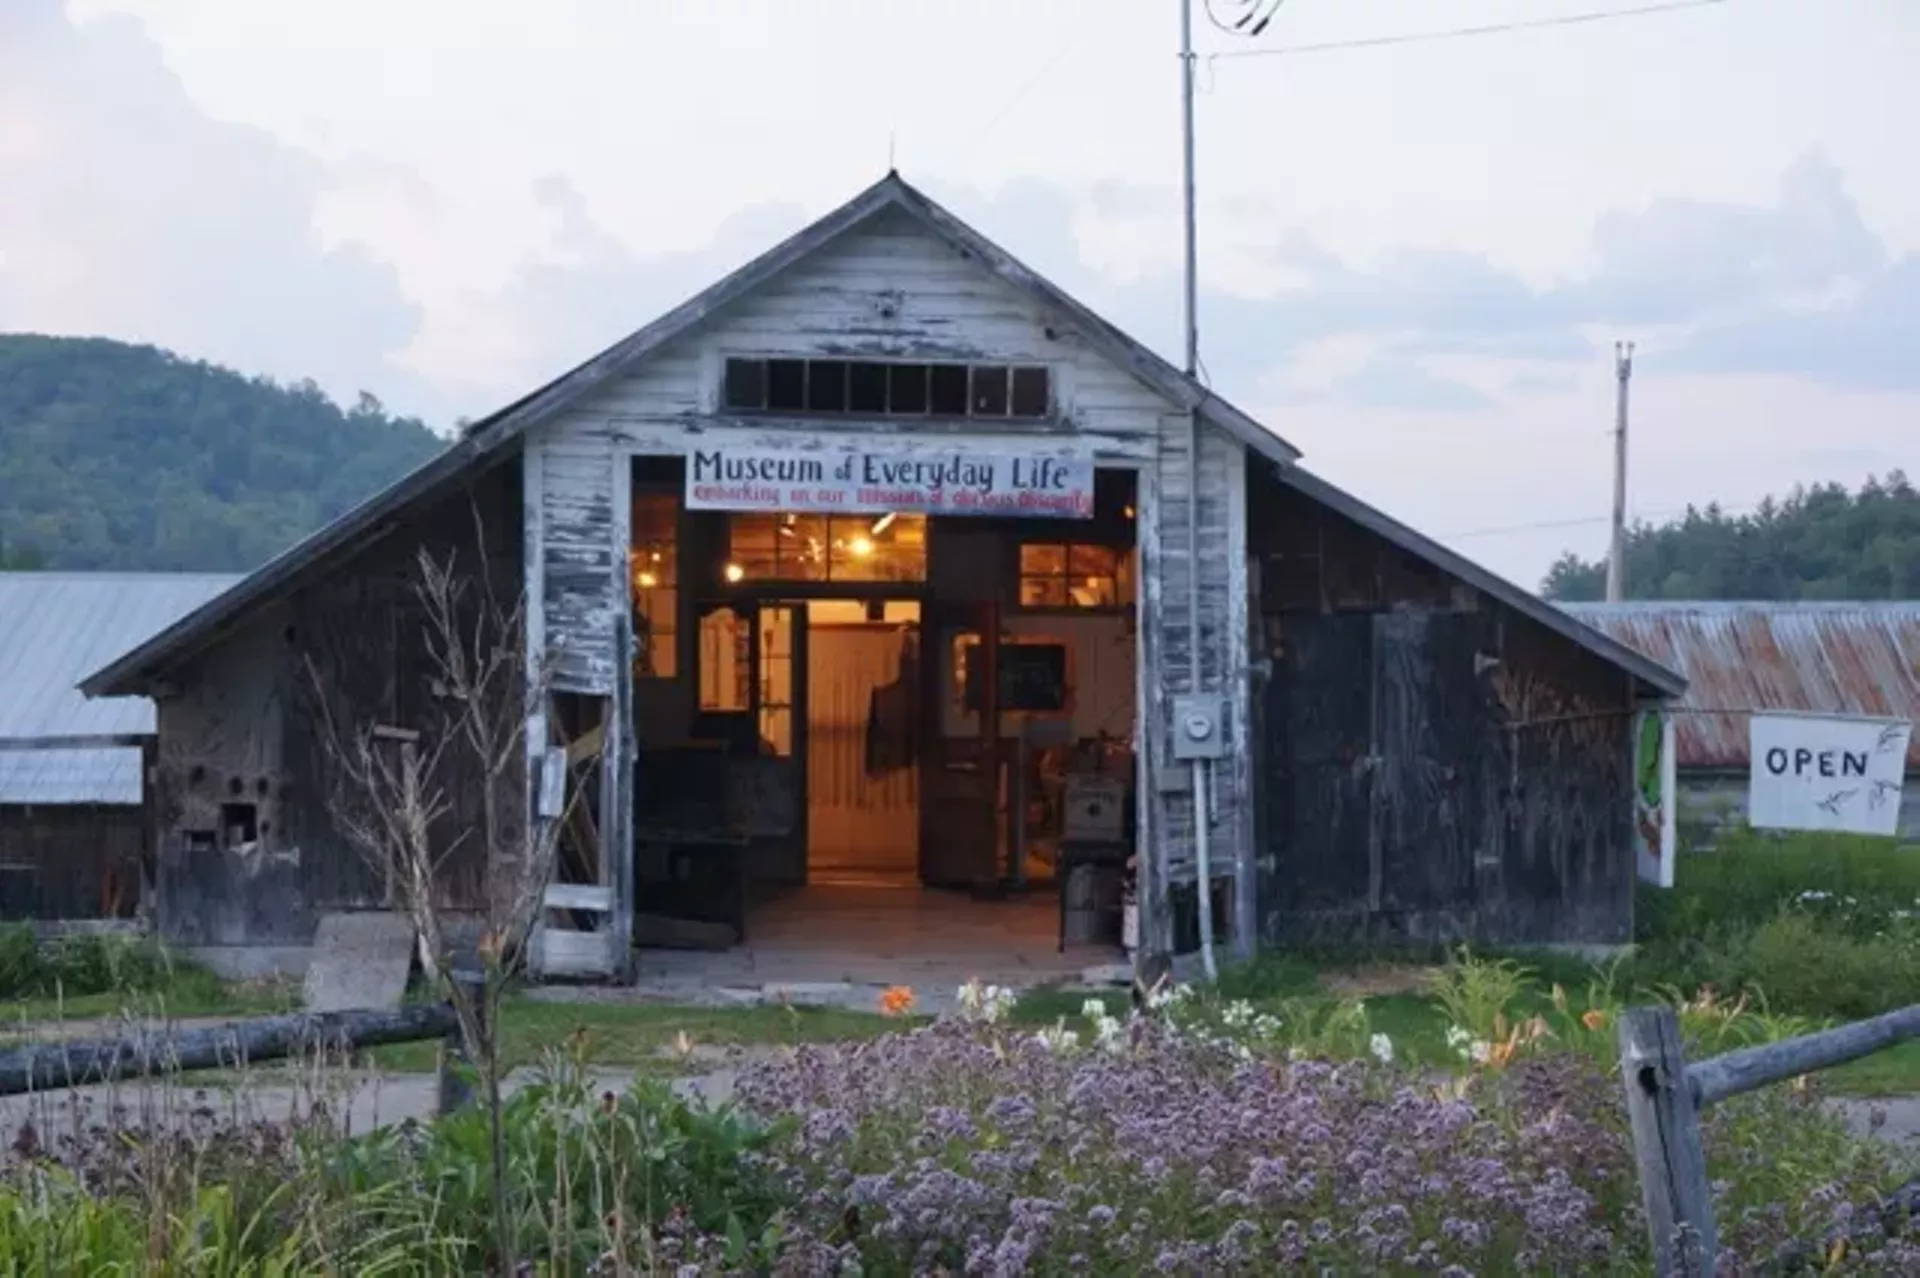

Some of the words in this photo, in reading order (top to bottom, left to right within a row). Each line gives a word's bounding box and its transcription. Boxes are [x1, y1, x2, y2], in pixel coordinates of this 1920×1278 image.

[694, 451, 823, 483] Museum
[834, 455, 853, 482] of
[863, 454, 994, 491] Everyday
[1011, 457, 1069, 489] Life
[1765, 747, 1868, 777] OPEN
